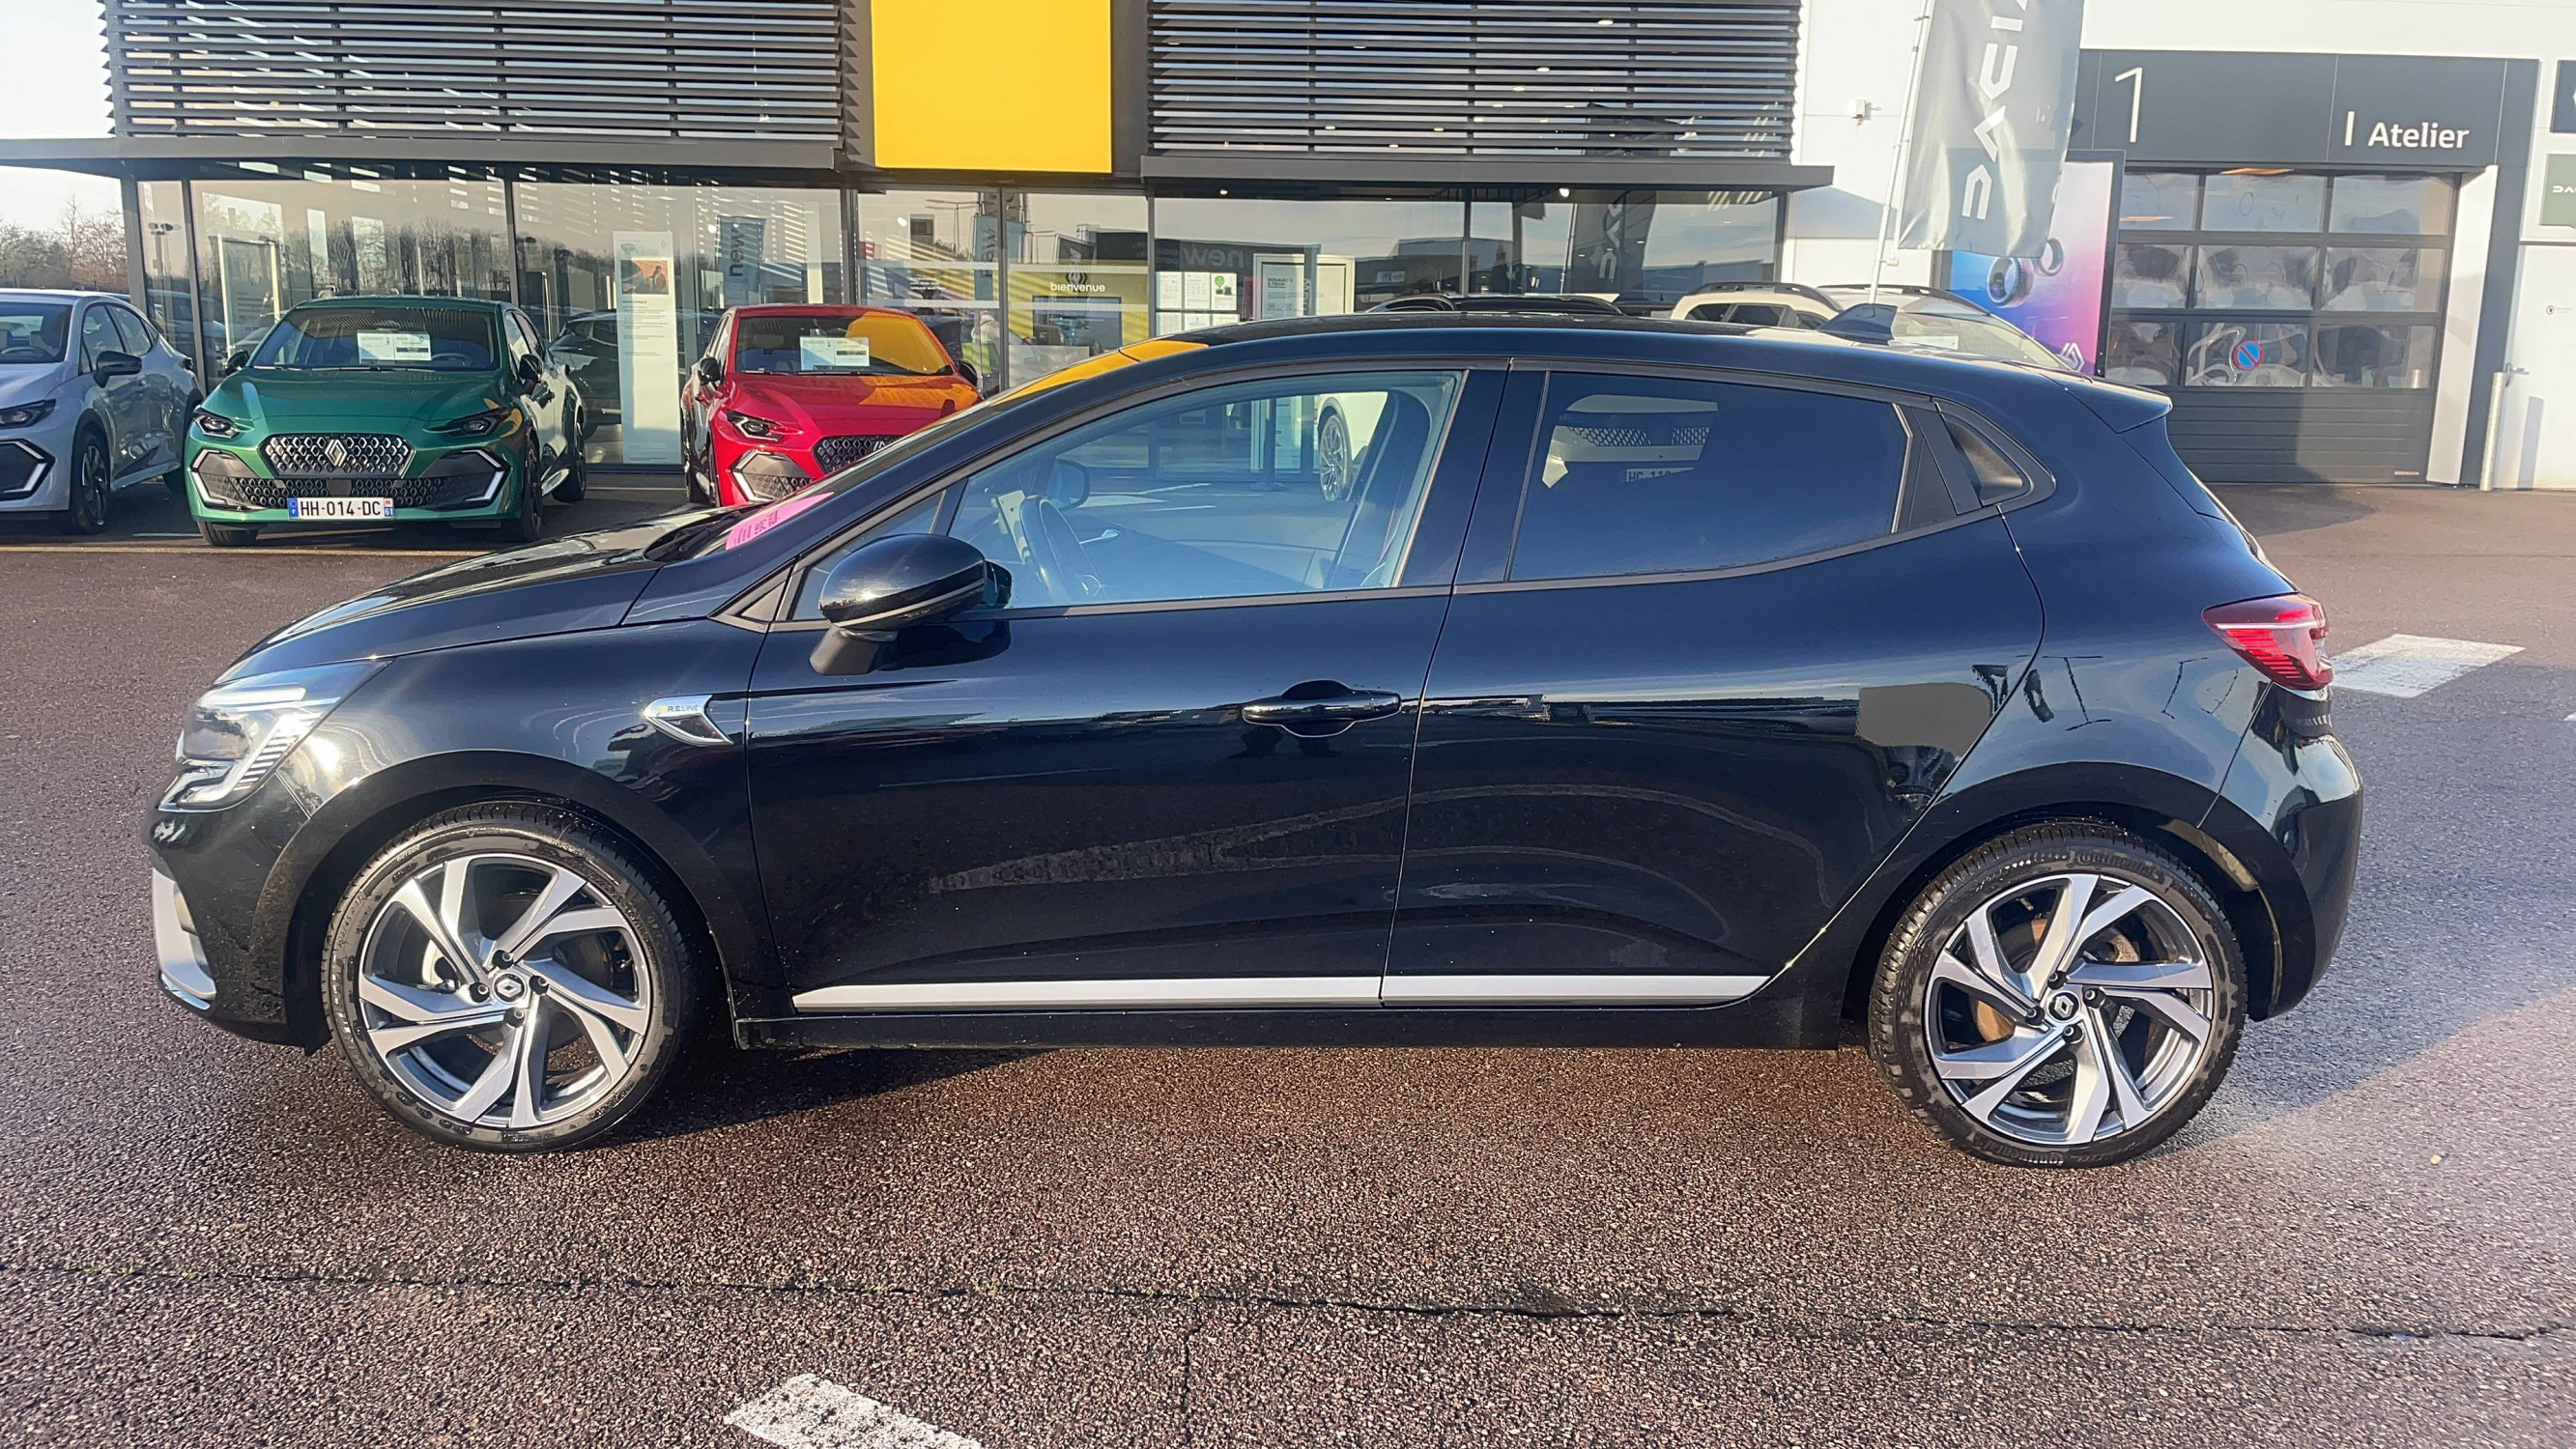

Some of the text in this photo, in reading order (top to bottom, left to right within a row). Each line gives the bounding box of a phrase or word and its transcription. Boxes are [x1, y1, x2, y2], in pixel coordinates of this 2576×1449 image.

[1962, 0, 2028, 220] DACI
[2114, 67, 2143, 143] 1
[2367, 122, 2470, 149] Atelier
[1050, 282, 1106, 292] bienvenue
[300, 500, 381, 516] HH-014-DC
